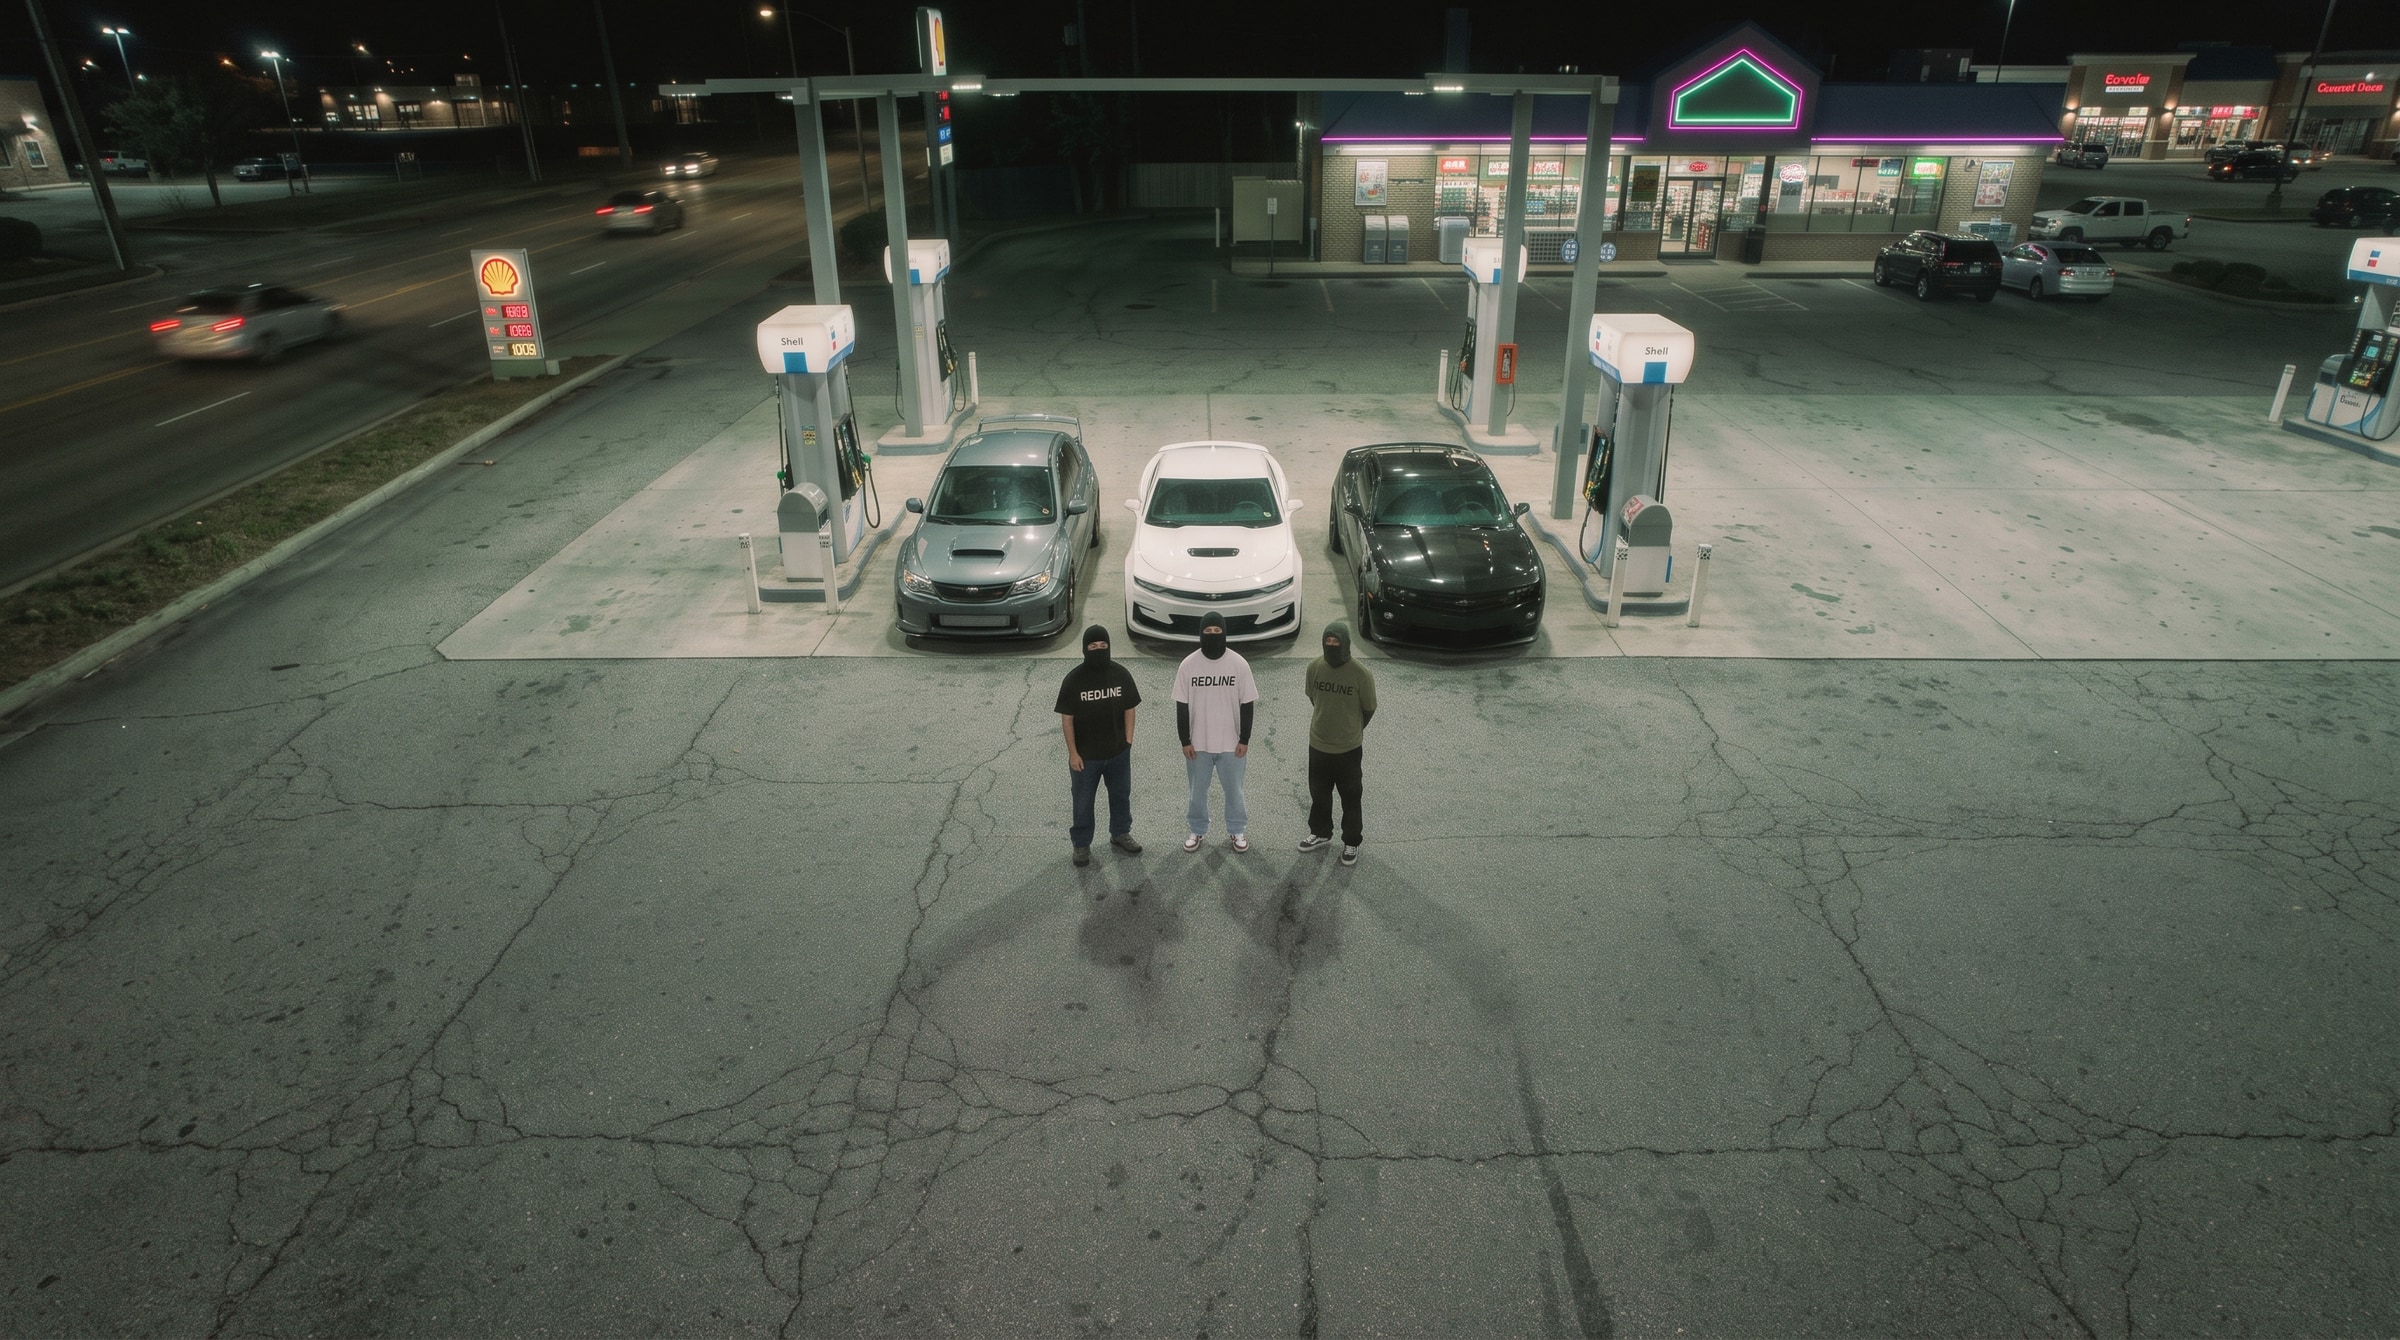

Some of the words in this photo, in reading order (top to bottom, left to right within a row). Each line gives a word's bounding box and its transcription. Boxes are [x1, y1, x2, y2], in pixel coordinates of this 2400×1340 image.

[781, 337, 804, 346] Shell
[1644, 346, 1669, 356] Shell
[1191, 675, 1236, 687] REDLINE
[1080, 686, 1122, 701] REDLINE
